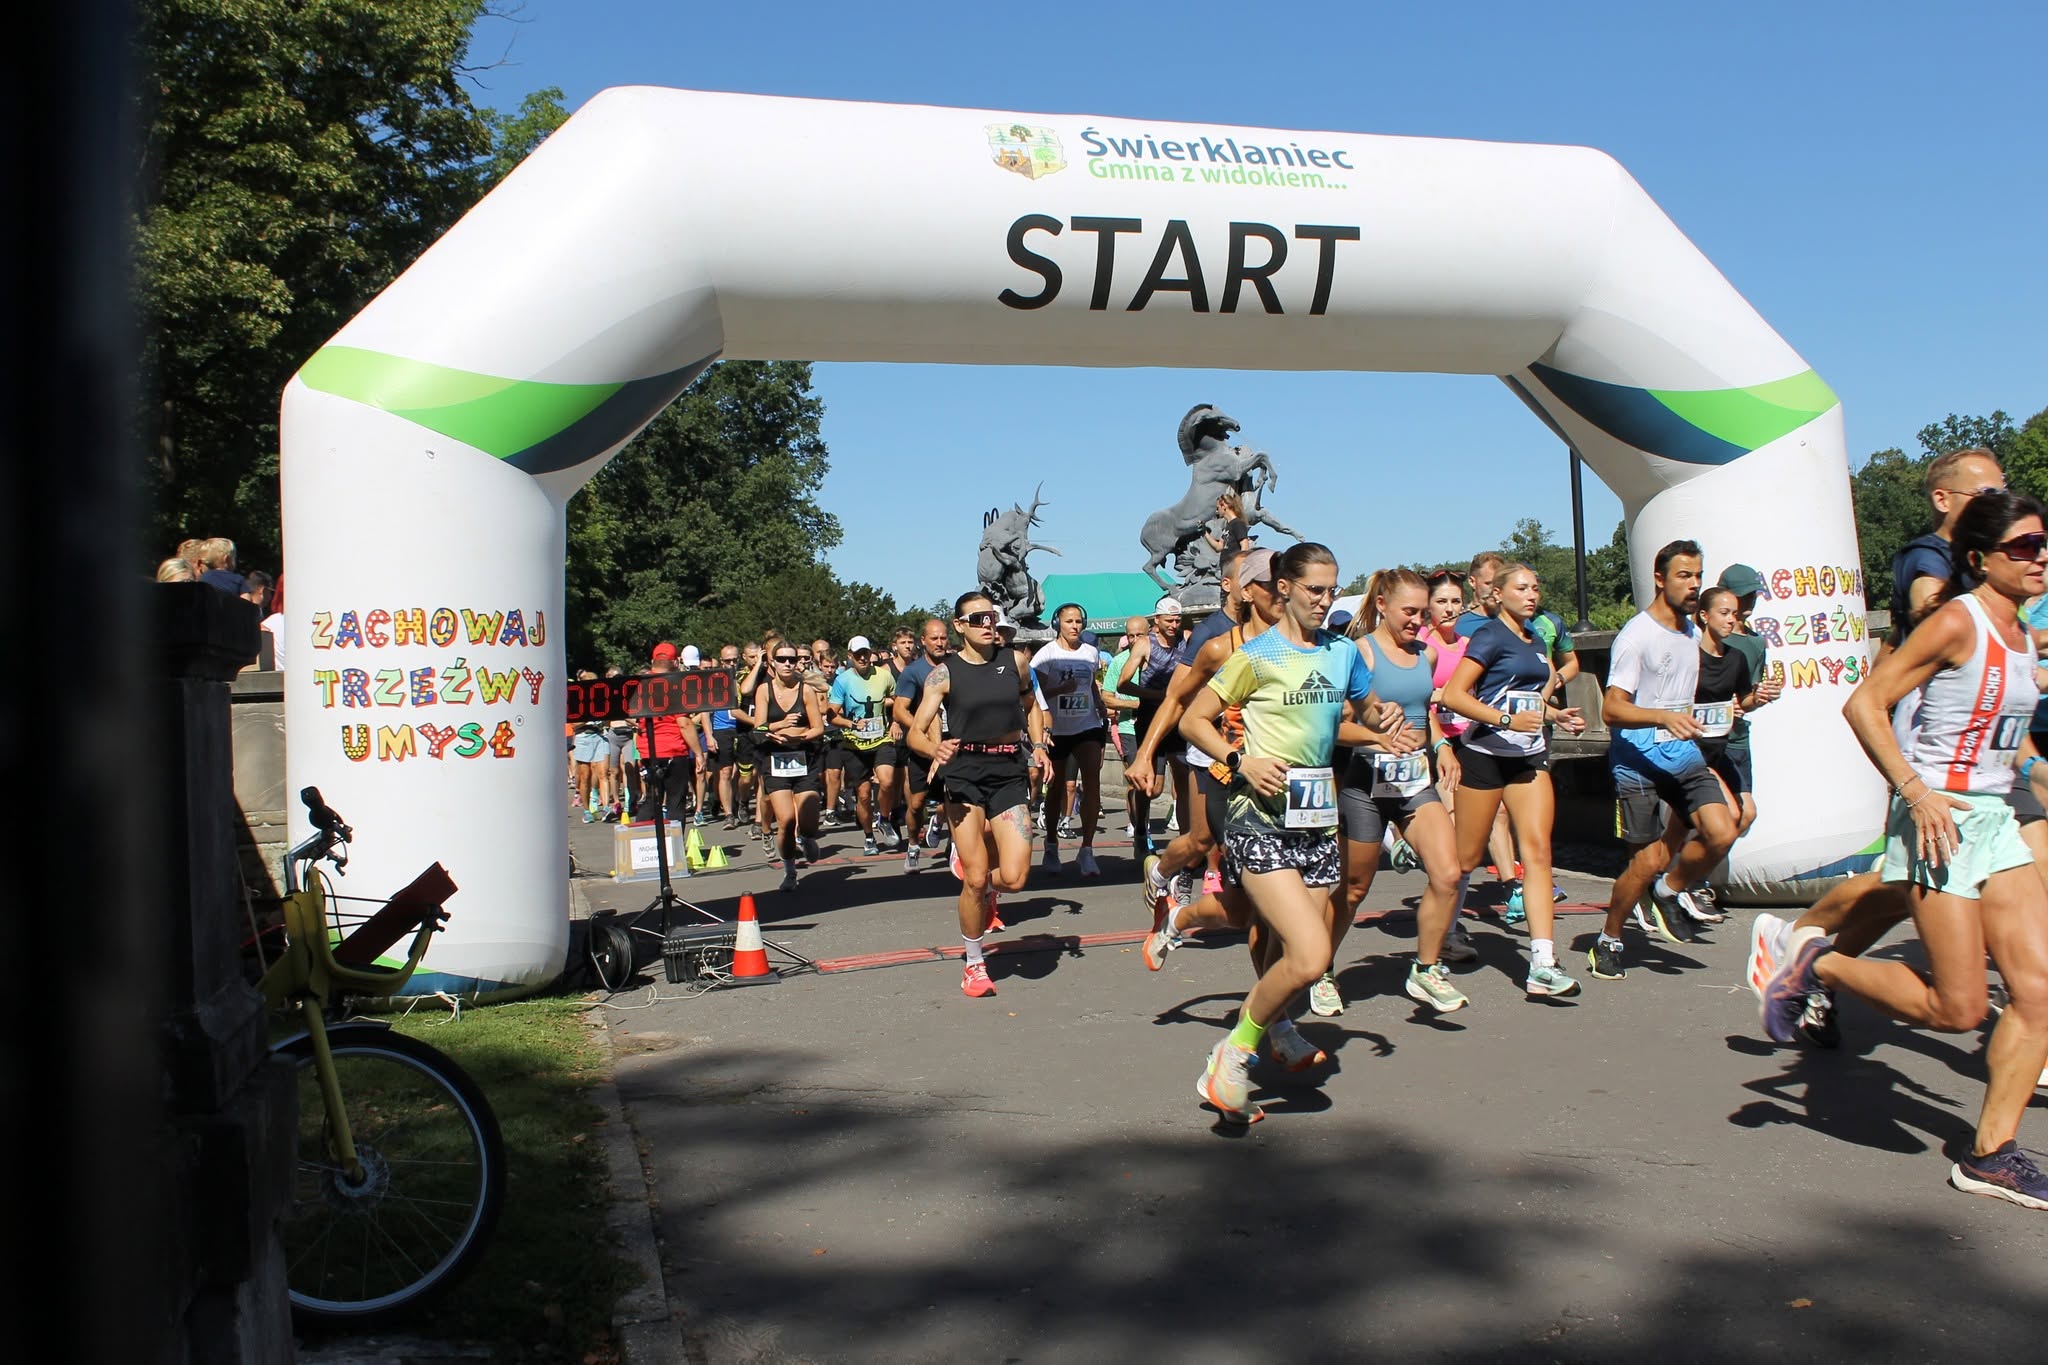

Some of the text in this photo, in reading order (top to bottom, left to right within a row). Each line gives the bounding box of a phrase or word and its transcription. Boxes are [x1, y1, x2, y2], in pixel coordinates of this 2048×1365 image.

[1080, 127, 1354, 169] Świerklaniec
[1088, 158, 1348, 190] Gmina z widokiem...
[997, 213, 1361, 315] START
[311, 608, 546, 650] ZACHOWAJ
[313, 657, 545, 708] TRZEŹWY
[1283, 691, 1324, 706] LECYMY
[1064, 696, 1086, 709] 722
[1695, 707, 1728, 725] 803
[340, 720, 516, 762] UMYSŁ
[1384, 759, 1423, 782] 830
[1299, 780, 1333, 808] 784
